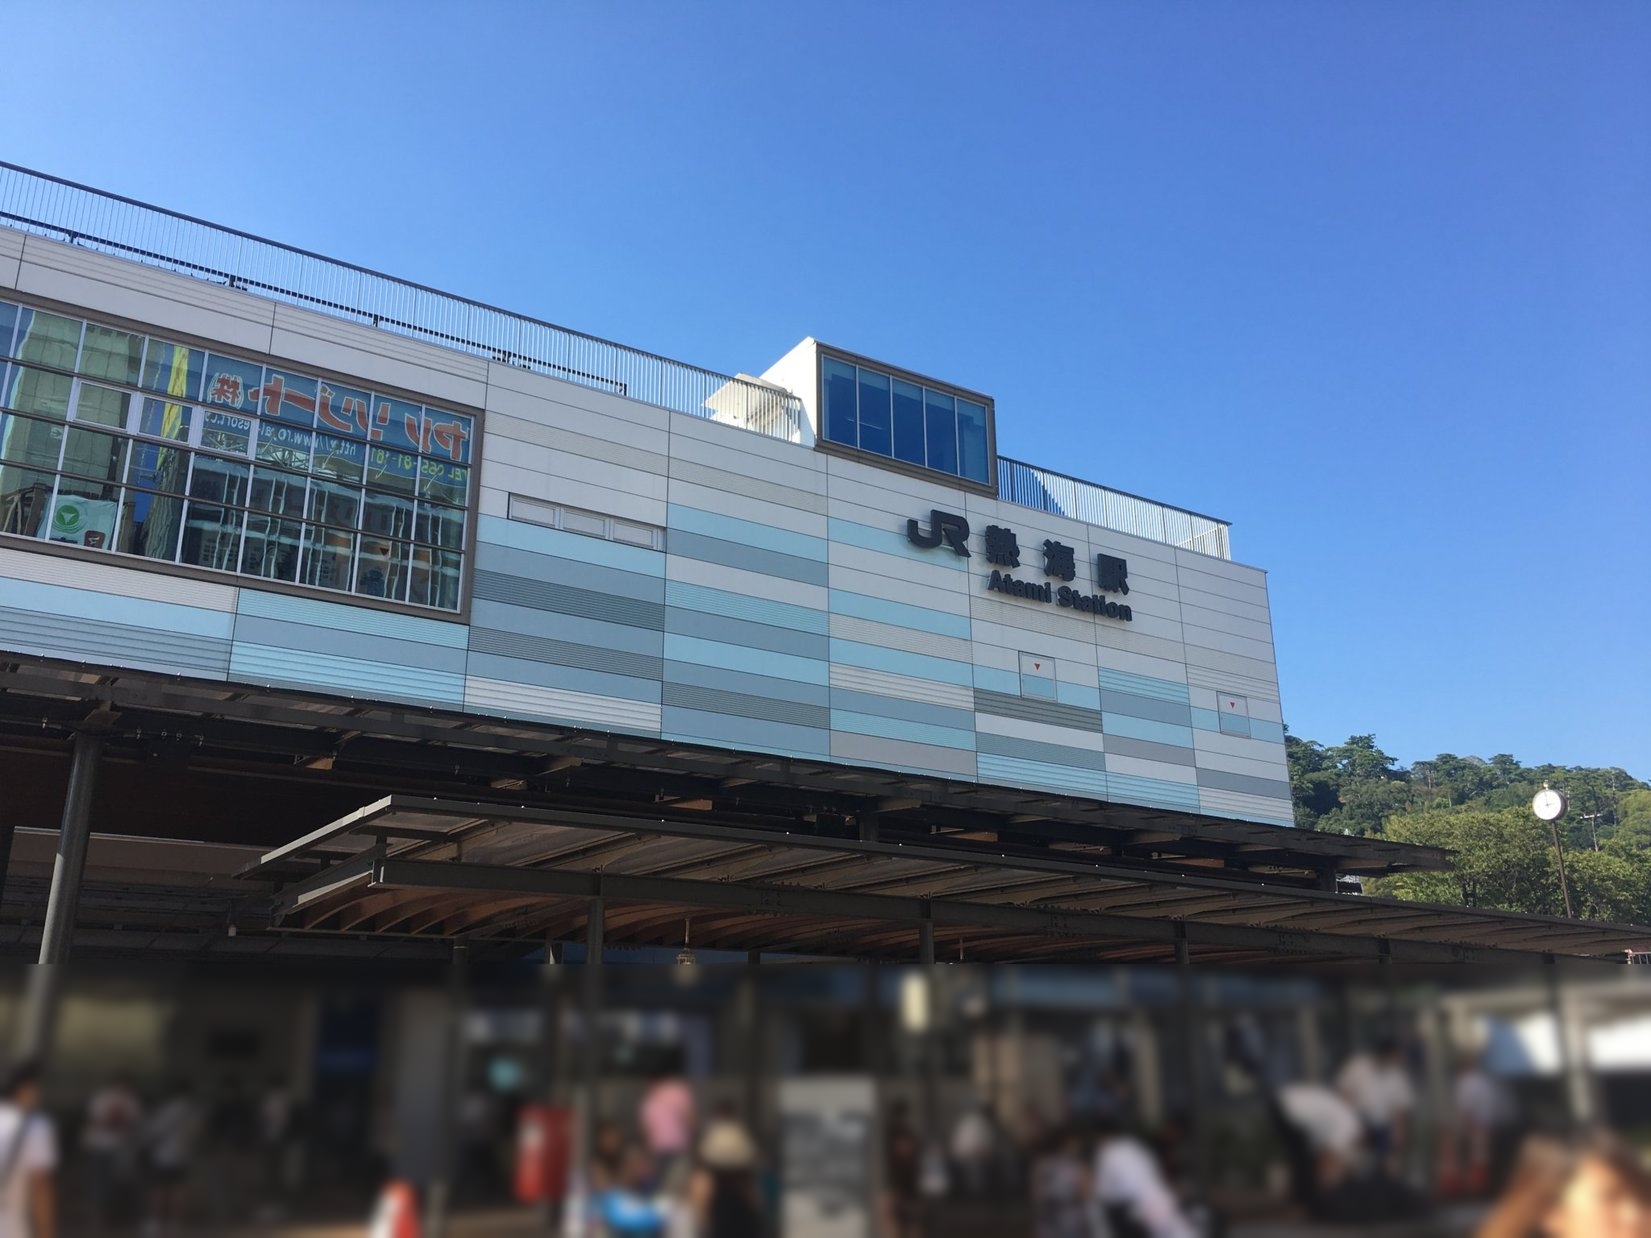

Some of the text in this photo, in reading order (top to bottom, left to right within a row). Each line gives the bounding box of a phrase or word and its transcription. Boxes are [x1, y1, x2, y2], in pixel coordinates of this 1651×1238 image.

[907, 509, 1130, 595] JR 熱海駅
[987, 570, 1133, 621] Atami Station
